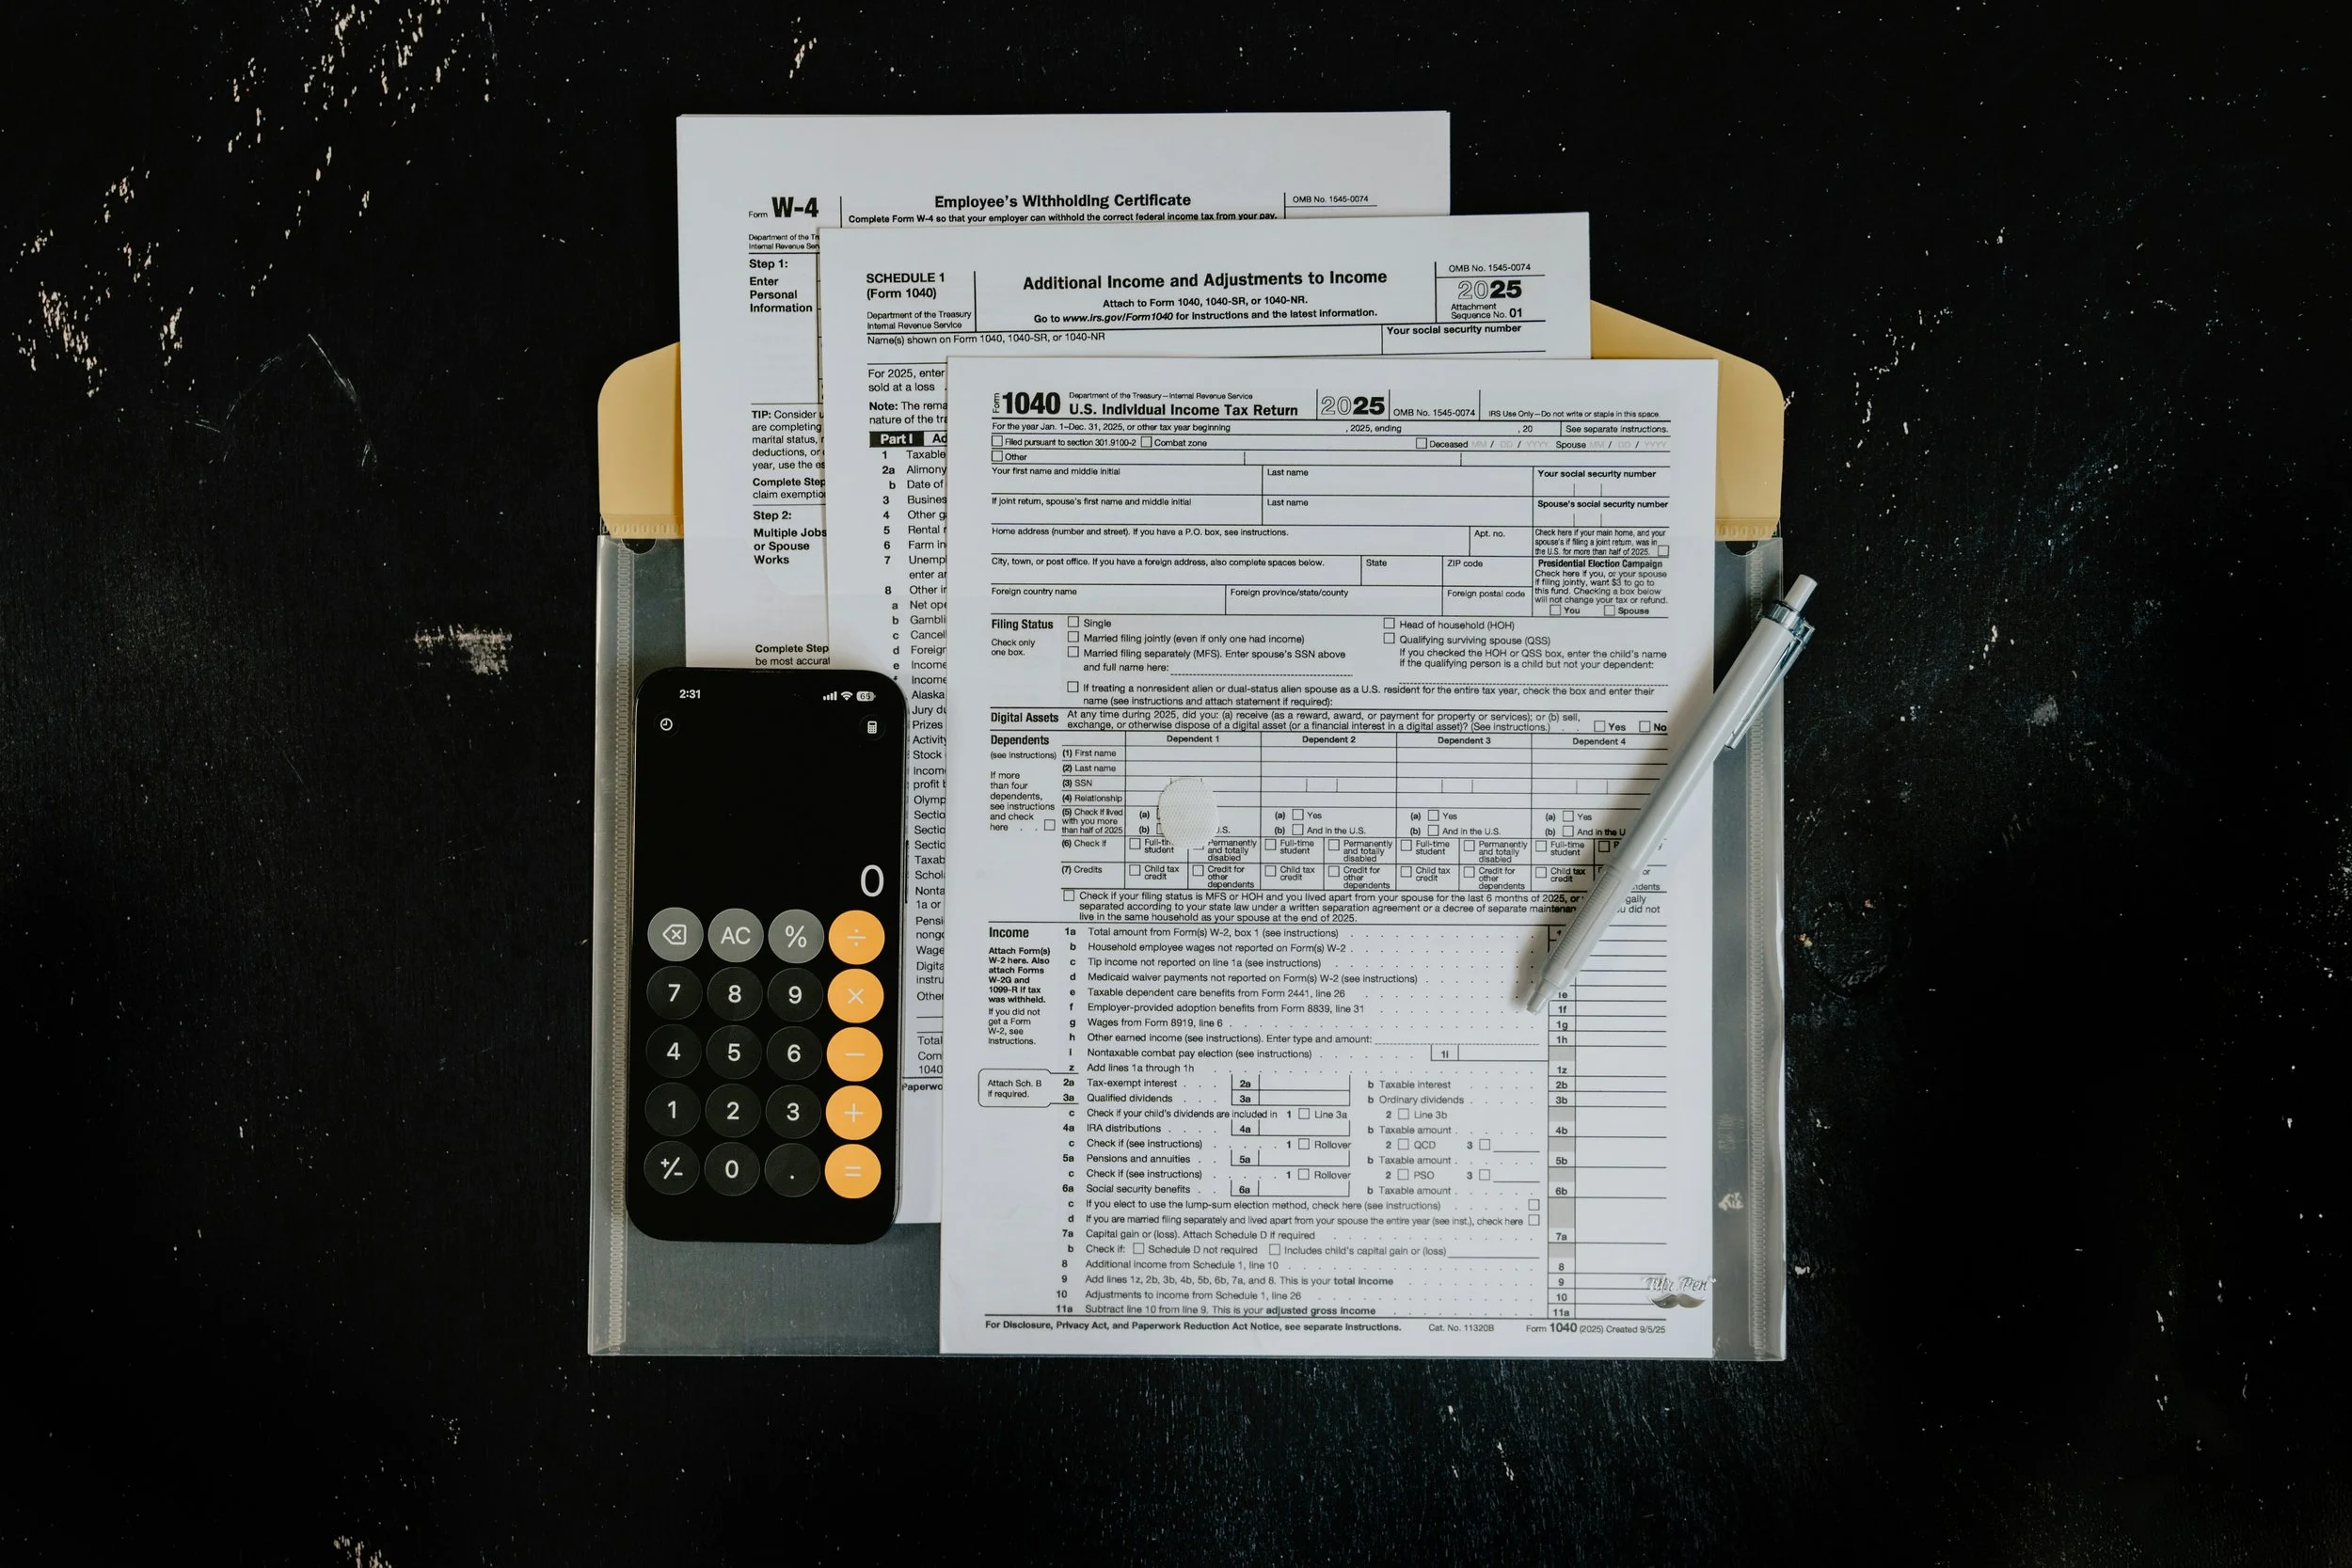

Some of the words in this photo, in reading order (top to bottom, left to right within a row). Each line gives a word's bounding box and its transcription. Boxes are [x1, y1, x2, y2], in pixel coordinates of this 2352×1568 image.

[934, 195, 1018, 211] Employee's
[1022, 194, 1110, 210] Withholding
[1114, 193, 1192, 207] Certificate
[1292, 195, 1312, 204] OMB
[1329, 195, 1369, 203] 1545-0074
[771, 196, 819, 218] W-4
[748, 211, 769, 219] Form
[749, 258, 775, 271] Step
[778, 259, 788, 269] 1:
[1448, 264, 1470, 273] OMB
[1471, 264, 1486, 273] No.
[1488, 262, 1532, 272] 1545-0074
[749, 276, 779, 287] Enter
[866, 272, 936, 284] SCHEDULE
[939, 272, 945, 283] 1
[1023, 275, 1102, 291] Additional
[1107, 275, 1165, 289] Income
[1169, 273, 1199, 288] and
[1203, 272, 1303, 290] Adjustments
[1307, 271, 1325, 285] to
[1329, 270, 1388, 284] Income
[749, 289, 798, 300] Personal
[866, 288, 902, 301] (Form
[905, 287, 937, 300] 1040)
[1457, 279, 1522, 300] 2025
[750, 302, 813, 313] Information
[1103, 298, 1135, 309] Attach
[1136, 299, 1148, 308] to
[1149, 298, 1175, 308] Form
[1177, 297, 1203, 308] 1040,
[1205, 296, 1248, 307] 1040-SR,
[1250, 297, 1262, 306] or
[1263, 295, 1309, 305] 1040-NR.
[1450, 302, 1498, 311] Attachment
[866, 311, 913, 321] Department
[914, 310, 923, 319] of
[923, 310, 937, 319] the
[938, 310, 972, 320] Treasury
[1451, 310, 1493, 321] Sequence
[1493, 309, 1507, 319] No.
[1508, 308, 1522, 319] 01
[866, 322, 897, 330] Internal
[898, 322, 932, 330] Revenue
[933, 321, 962, 329] Service
[1386, 326, 1410, 335] Your
[1412, 325, 1441, 335] social
[1443, 325, 1483, 335] security
[1484, 324, 1522, 333] number
[868, 401, 898, 411] Note:
[992, 392, 1000, 414] Form
[1002, 391, 1061, 415] 1040
[1320, 395, 1386, 416] 2025
[751, 410, 771, 420] TIP:
[773, 409, 818, 420] Consider
[1069, 403, 1097, 416] U.S.
[1102, 403, 1166, 416] Individual
[1170, 404, 1220, 416] Income
[1223, 404, 1248, 417] Tax
[1253, 404, 1298, 417] Return
[1392, 408, 1415, 417] OMB
[1416, 408, 1431, 417] No.
[1433, 408, 1476, 417] 1545-0074
[880, 434, 907, 445] Part
[909, 433, 914, 444] I
[1153, 438, 1186, 447] Combat
[882, 450, 887, 460] 1
[905, 449, 946, 460] Taxable
[1004, 452, 1027, 462] Other
[882, 465, 896, 475] 2a
[906, 465, 948, 476] Alimony
[1537, 469, 1559, 478] Your
[1560, 469, 1586, 478] social
[1587, 469, 1622, 480] security
[1623, 469, 1657, 478] number
[753, 510, 779, 522] Step
[781, 510, 792, 520] 2:
[753, 543, 766, 551] or
[768, 541, 810, 553] Spouse
[883, 540, 891, 550] 6
[908, 540, 934, 550] Farm
[753, 554, 790, 565] Works
[1365, 558, 1388, 567] State
[1447, 559, 1462, 567] ZIP
[1463, 560, 1484, 568] code
[1537, 559, 1586, 568] Presidential
[1587, 559, 1621, 568] Election
[1621, 559, 1663, 570] Campaign
[992, 618, 1019, 632] Filing
[1021, 618, 1054, 630] Status
[1083, 618, 1112, 629] Single
[1399, 620, 1424, 629] Head
[1425, 620, 1436, 629] of
[1438, 620, 1486, 630] household
[1486, 620, 1515, 632] (HOH)
[679, 689, 701, 699] 2:31
[911, 689, 946, 700] Alaska
[991, 711, 1023, 725] Digital
[1025, 712, 1059, 723] Assets
[912, 720, 944, 730] Prizes
[1608, 722, 1627, 732] Yes
[1653, 722, 1668, 732] No
[991, 734, 1050, 748] Dependents
[1167, 735, 1213, 744] Dependent
[1215, 735, 1219, 743] 1
[1302, 736, 1349, 745] Dependent
[1350, 736, 1357, 744] 2
[1438, 736, 1484, 746] Dependent
[1486, 736, 1491, 745] 3
[1572, 736, 1619, 747] Dependent
[1620, 737, 1627, 746] 4
[913, 750, 943, 760] Stock
[860, 864, 884, 897] 0
[720, 926, 751, 945] AC
[785, 925, 807, 948] %
[989, 927, 1029, 939] Income
[668, 983, 681, 1003] 7
[727, 984, 742, 1004] 8
[788, 985, 803, 1005] 9
[1069, 1019, 1076, 1028] g
[1087, 1018, 1120, 1029] Wages
[1120, 1018, 1142, 1027] from
[1144, 1018, 1168, 1027] Form
[1170, 1018, 1196, 1028] 8919,
[1199, 1019, 1215, 1028] line
[1216, 1019, 1223, 1028] 6
[1556, 1035, 1568, 1044] 1h
[666, 1041, 681, 1061] 4
[727, 1042, 741, 1062] 5
[787, 1043, 802, 1063] 6
[1062, 1078, 1075, 1087] 2a
[1087, 1078, 1141, 1089] Tax-exempt
[1143, 1078, 1178, 1088] interest
[1378, 1080, 1416, 1089] Taxable
[1417, 1080, 1452, 1089] interest
[1555, 1081, 1568, 1089] 2b
[667, 1100, 676, 1119] 1
[726, 1101, 739, 1120] 2
[787, 1102, 800, 1121] 3
[724, 1159, 739, 1179] 0
[1413, 1170, 1435, 1180] PSO
[1086, 1183, 1114, 1194] Social
[1116, 1184, 1152, 1196] security
[1154, 1184, 1191, 1194] benefits
[1555, 1232, 1567, 1242] 7a
[1428, 1323, 1445, 1332] Cat.
[1447, 1323, 1461, 1332] No.
[1464, 1323, 1495, 1333] 11320B
[1526, 1324, 1548, 1333] Form
[1549, 1322, 1578, 1333] 1040
[1579, 1324, 1604, 1335] (2025)
[1605, 1324, 1638, 1334] Created
[1639, 1325, 1666, 1334] 9/5/25
